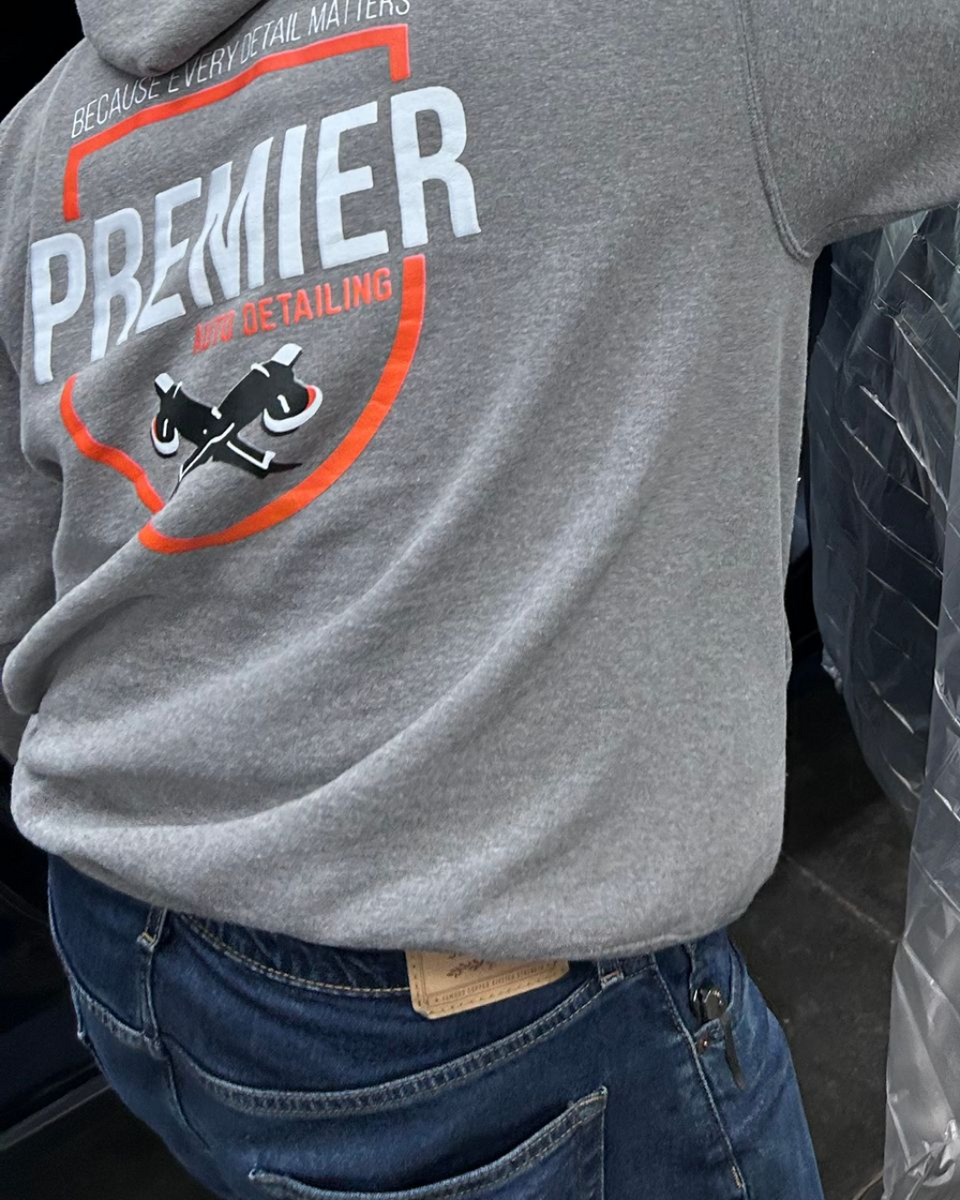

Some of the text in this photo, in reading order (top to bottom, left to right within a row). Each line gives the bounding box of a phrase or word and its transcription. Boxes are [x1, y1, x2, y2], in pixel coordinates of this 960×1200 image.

[71, 75, 159, 139] BECAUSE
[168, 44, 240, 93] EVERY
[240, 12, 302, 66] DETAIL
[31, 86, 481, 385] PREMIER
[192, 267, 392, 356] AUTO DETAILING
